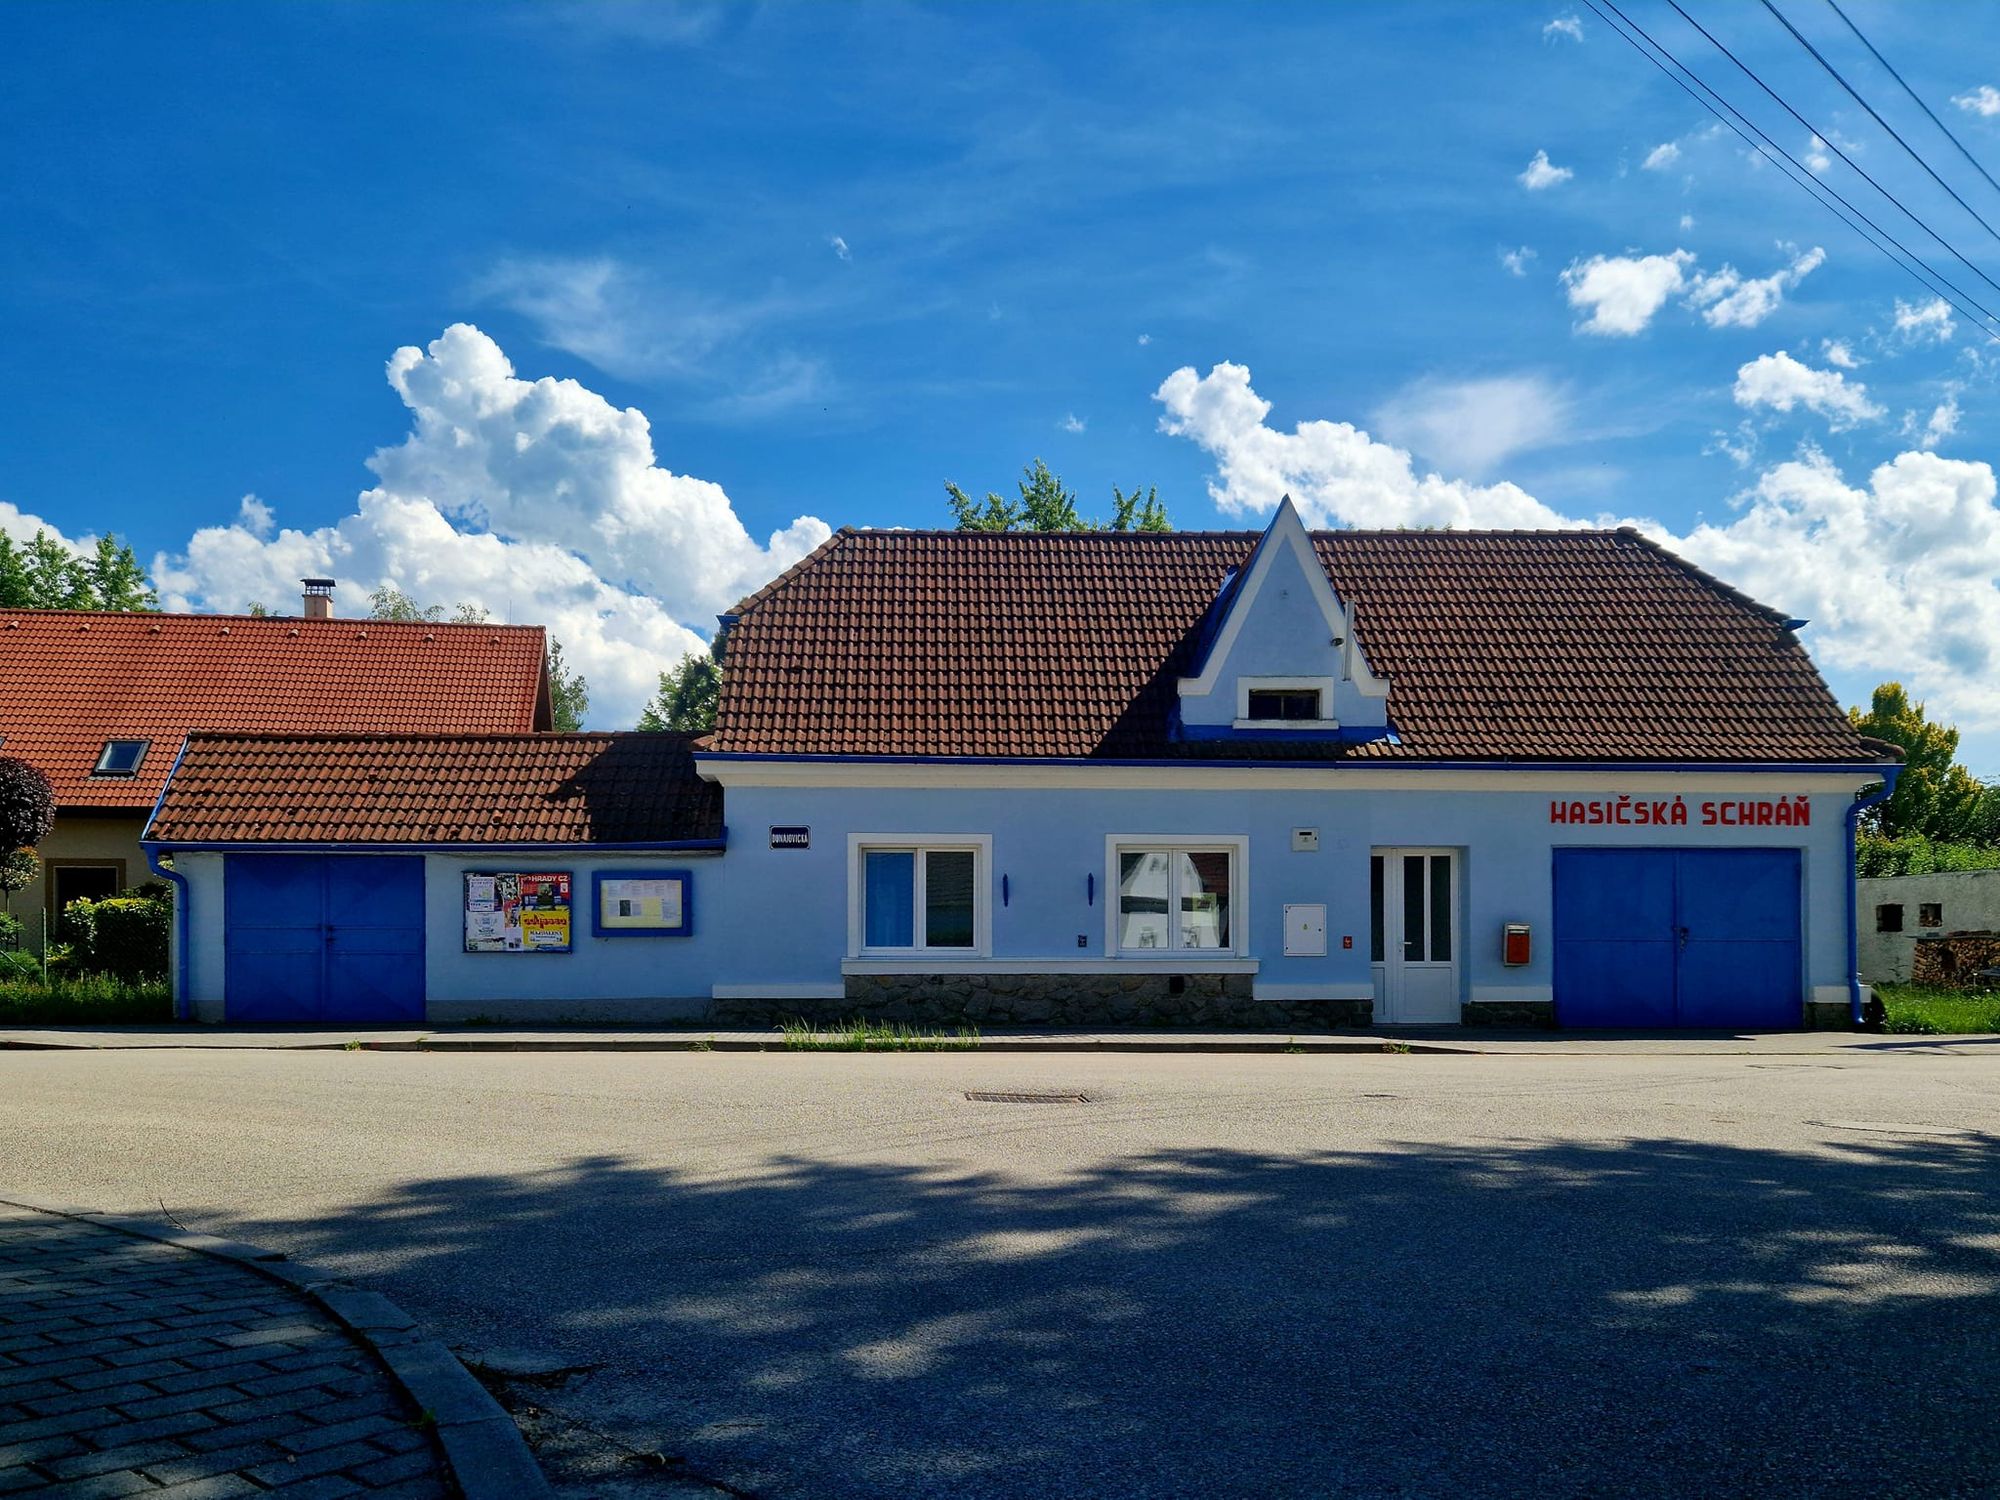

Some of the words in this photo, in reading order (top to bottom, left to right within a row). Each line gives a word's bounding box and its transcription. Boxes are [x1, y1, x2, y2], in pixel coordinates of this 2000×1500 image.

[1550, 794, 1688, 826] HASIČSKÁ
[1702, 795, 1811, 827] SCHRÁŇ
[772, 833, 808, 843] DUNAJOVICKÁ
